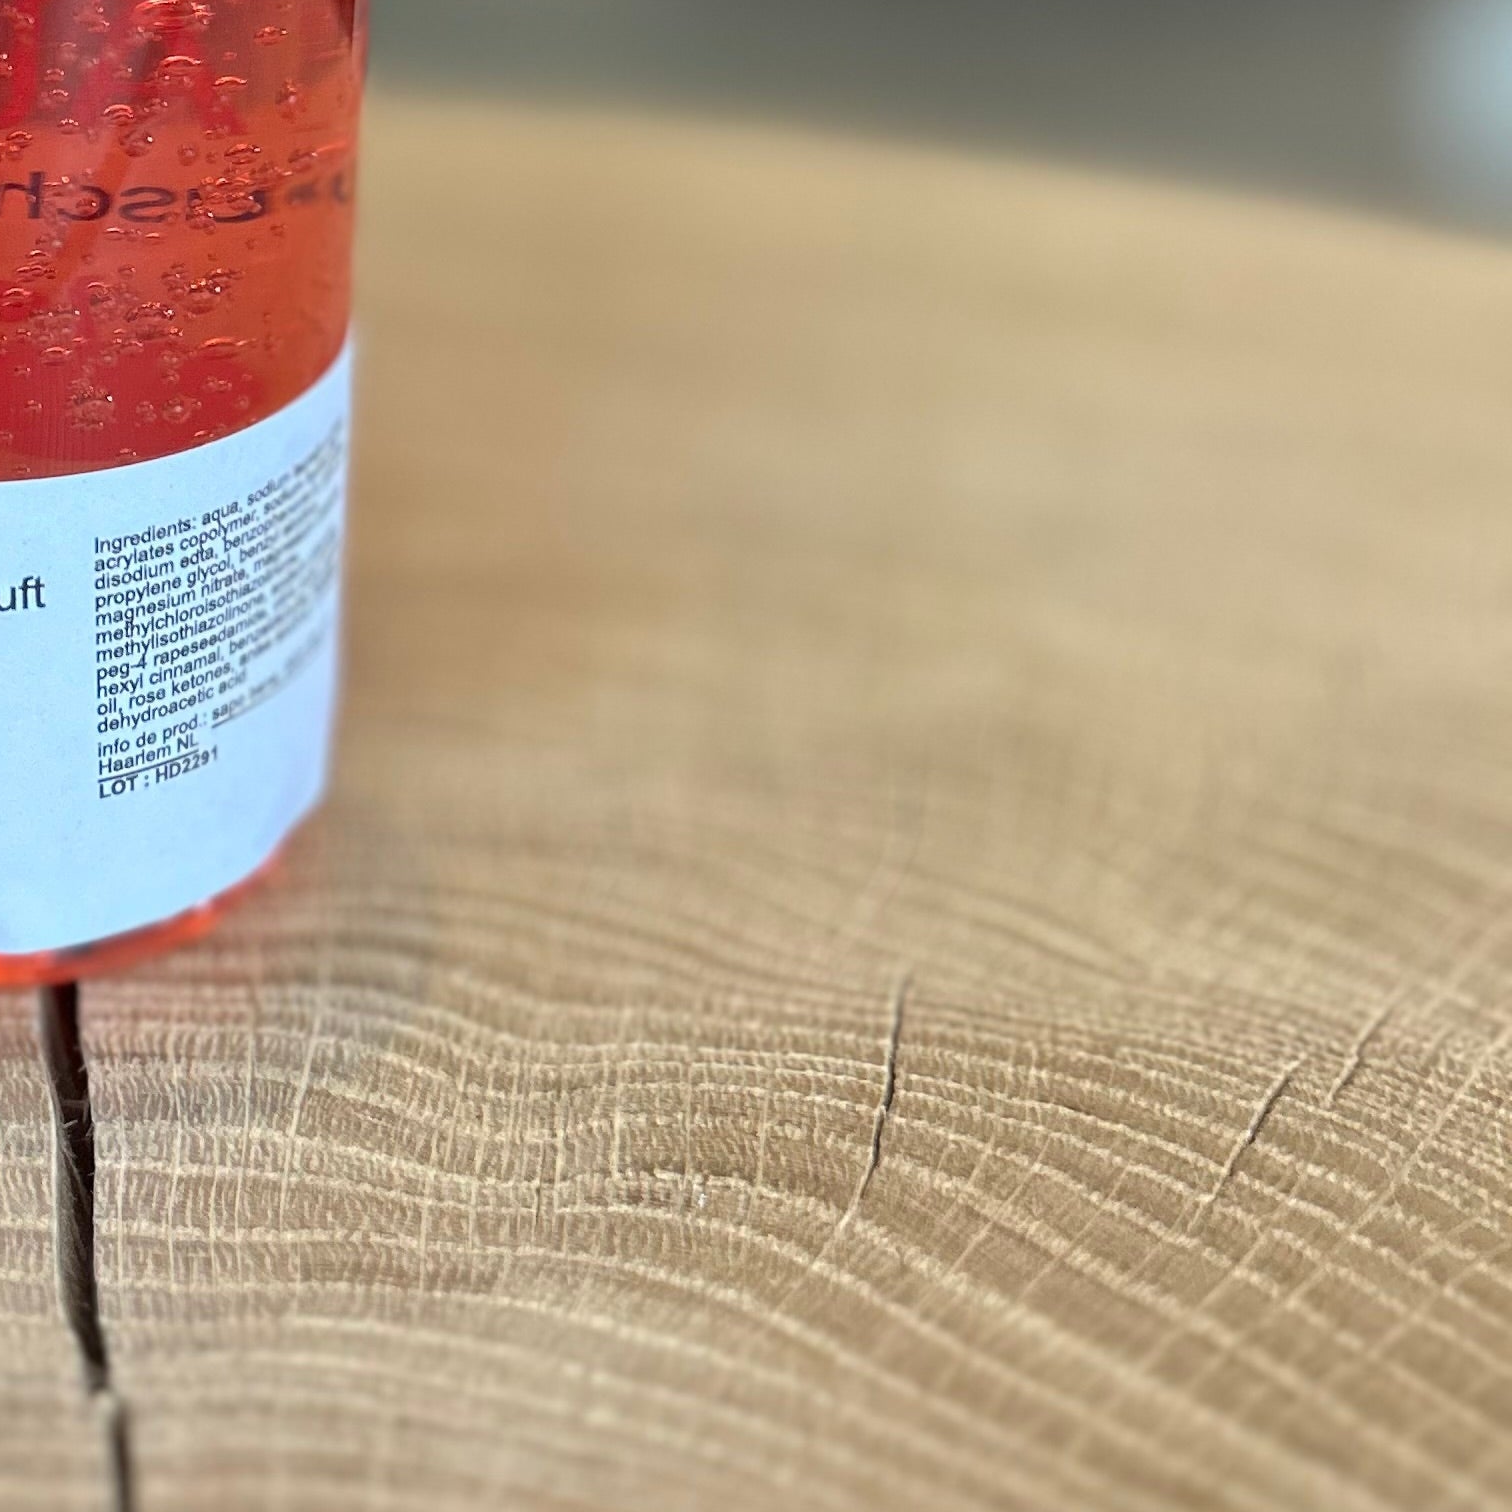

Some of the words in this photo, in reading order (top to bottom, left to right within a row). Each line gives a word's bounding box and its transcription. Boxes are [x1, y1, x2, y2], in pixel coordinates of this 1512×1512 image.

[94, 516, 197, 554] Ingredients:
[94, 540, 175, 573] acrylates
[94, 560, 175, 591] disodium
[95, 576, 182, 613] propylene
[95, 589, 197, 627] magnesium
[96, 652, 148, 681] peg-4
[97, 672, 144, 699] hexyl
[128, 687, 167, 709] rose
[97, 686, 215, 733] dehydroacetic
[98, 737, 131, 758] info
[135, 731, 158, 749] de
[98, 744, 172, 775] Haarlem
[176, 732, 200, 754] NL
[98, 773, 140, 799] LOT
[155, 744, 219, 784] HD2291
